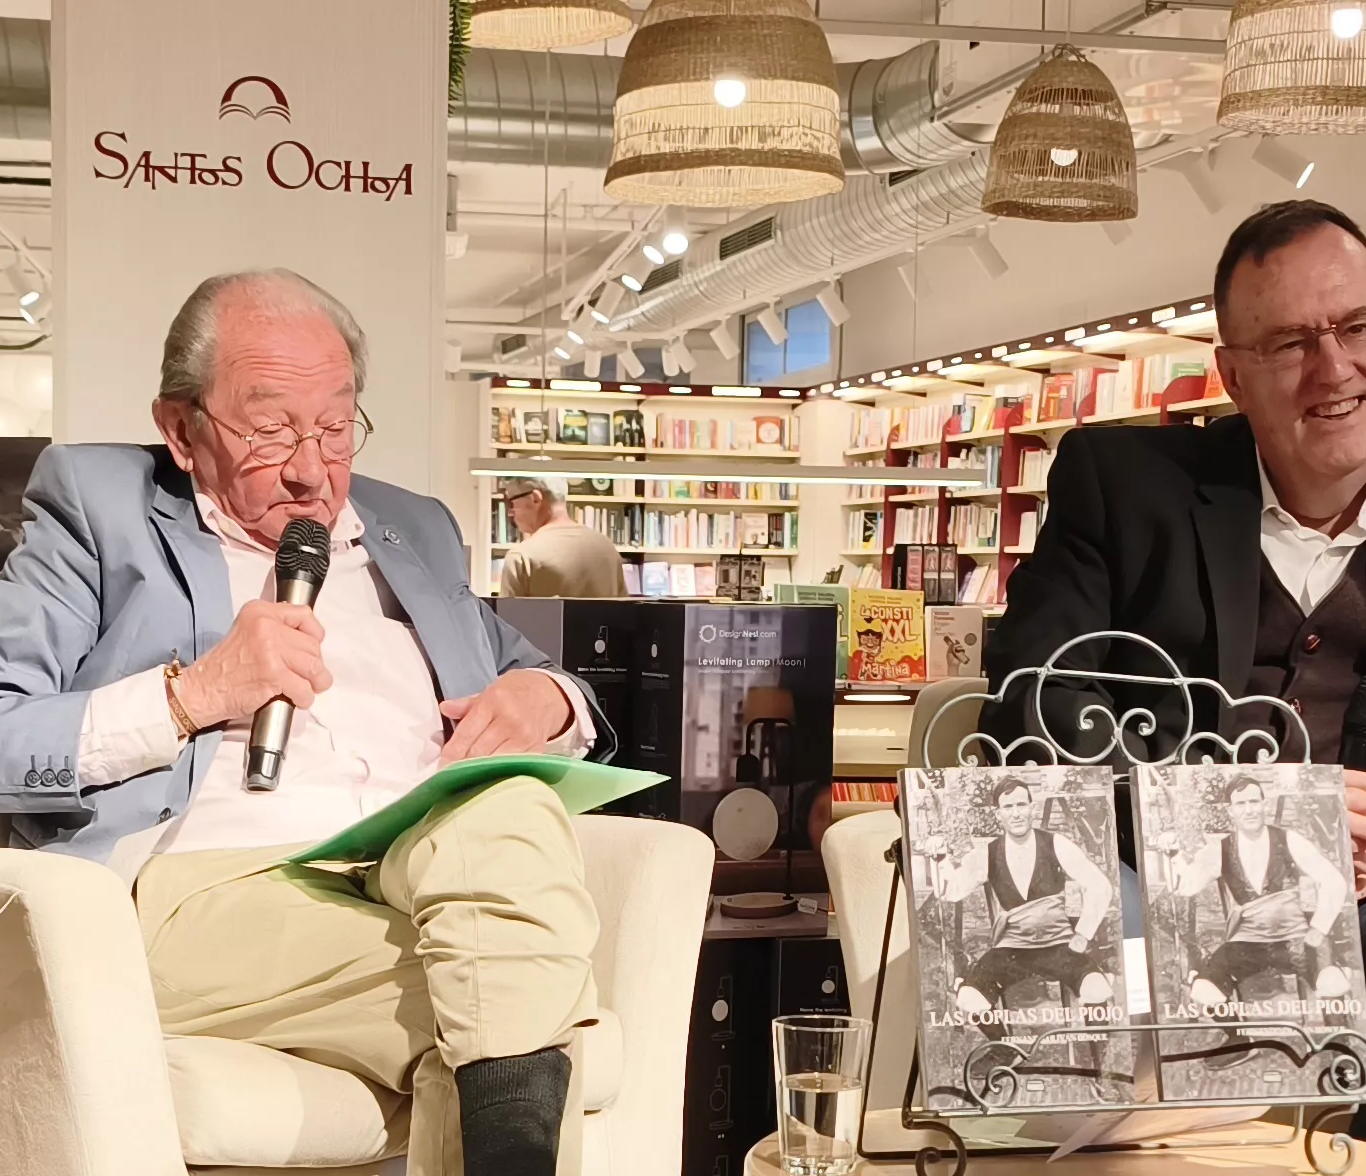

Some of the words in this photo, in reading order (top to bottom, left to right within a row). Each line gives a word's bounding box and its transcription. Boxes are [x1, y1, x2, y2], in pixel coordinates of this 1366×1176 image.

[92, 131, 243, 190] SANTOS
[266, 140, 414, 202] OCHOA
[871, 606, 913, 620] CONSTI
[881, 619, 919, 643] XXL
[698, 657, 743, 668] Levitating
[746, 658, 771, 668] Lamp
[929, 1011, 964, 1027] LAS
[968, 1008, 1037, 1026] COPLAS
[1041, 1007, 1075, 1024] DEL
[1077, 1005, 1124, 1023] PIOJO
[1164, 1003, 1199, 1019] LAS
[1202, 1000, 1273, 1018] COPLAS
[1277, 999, 1314, 1016] DEL
[1316, 998, 1362, 1015] PIOJO
